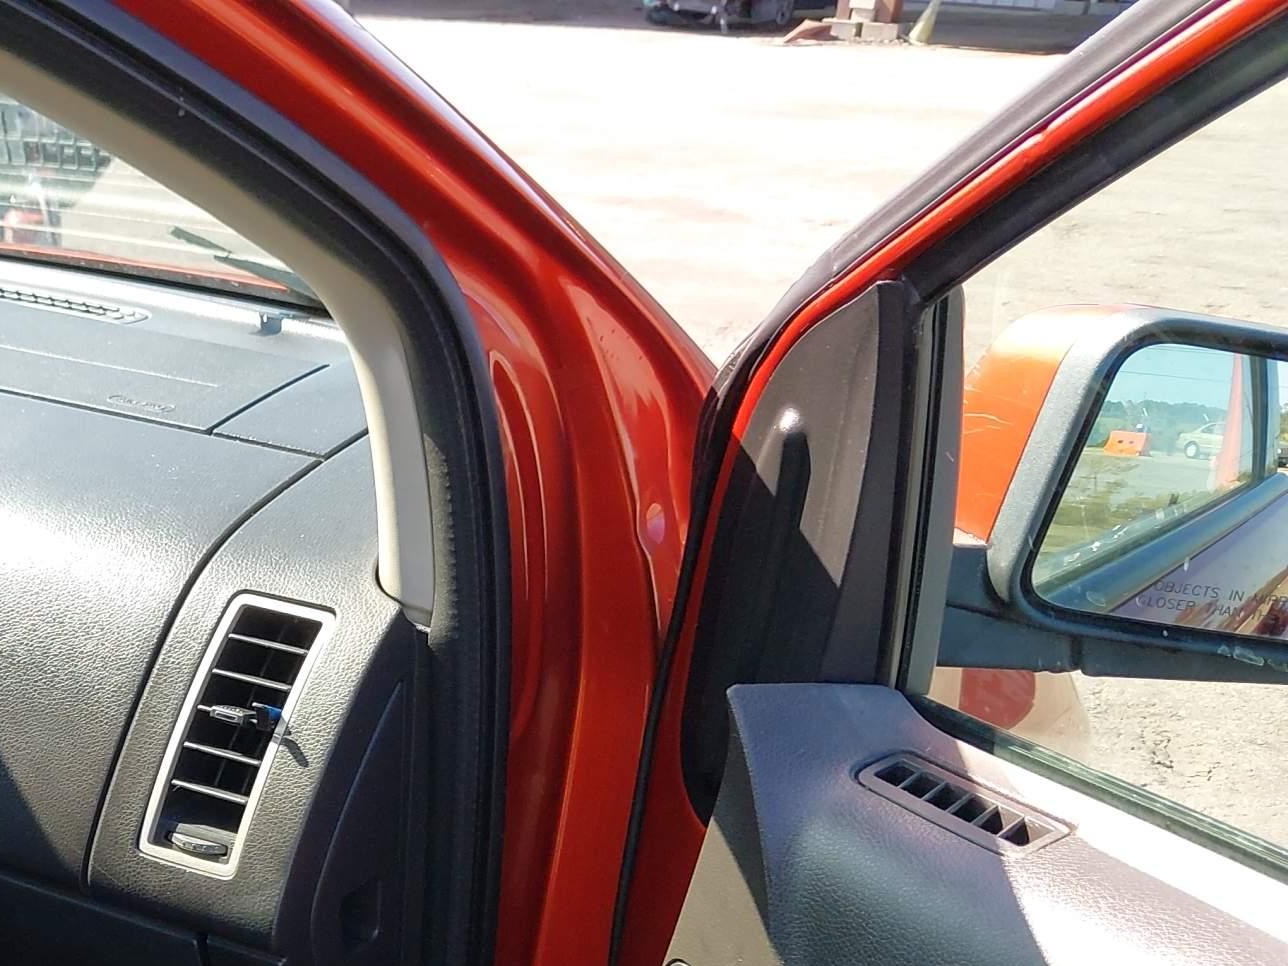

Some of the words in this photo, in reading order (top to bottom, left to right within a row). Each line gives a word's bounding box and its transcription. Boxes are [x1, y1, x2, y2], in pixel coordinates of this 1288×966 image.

[1154, 581, 1220, 599] OBJECTS
[1228, 589, 1245, 602] IN
[1138, 594, 1196, 612] CLOSER
